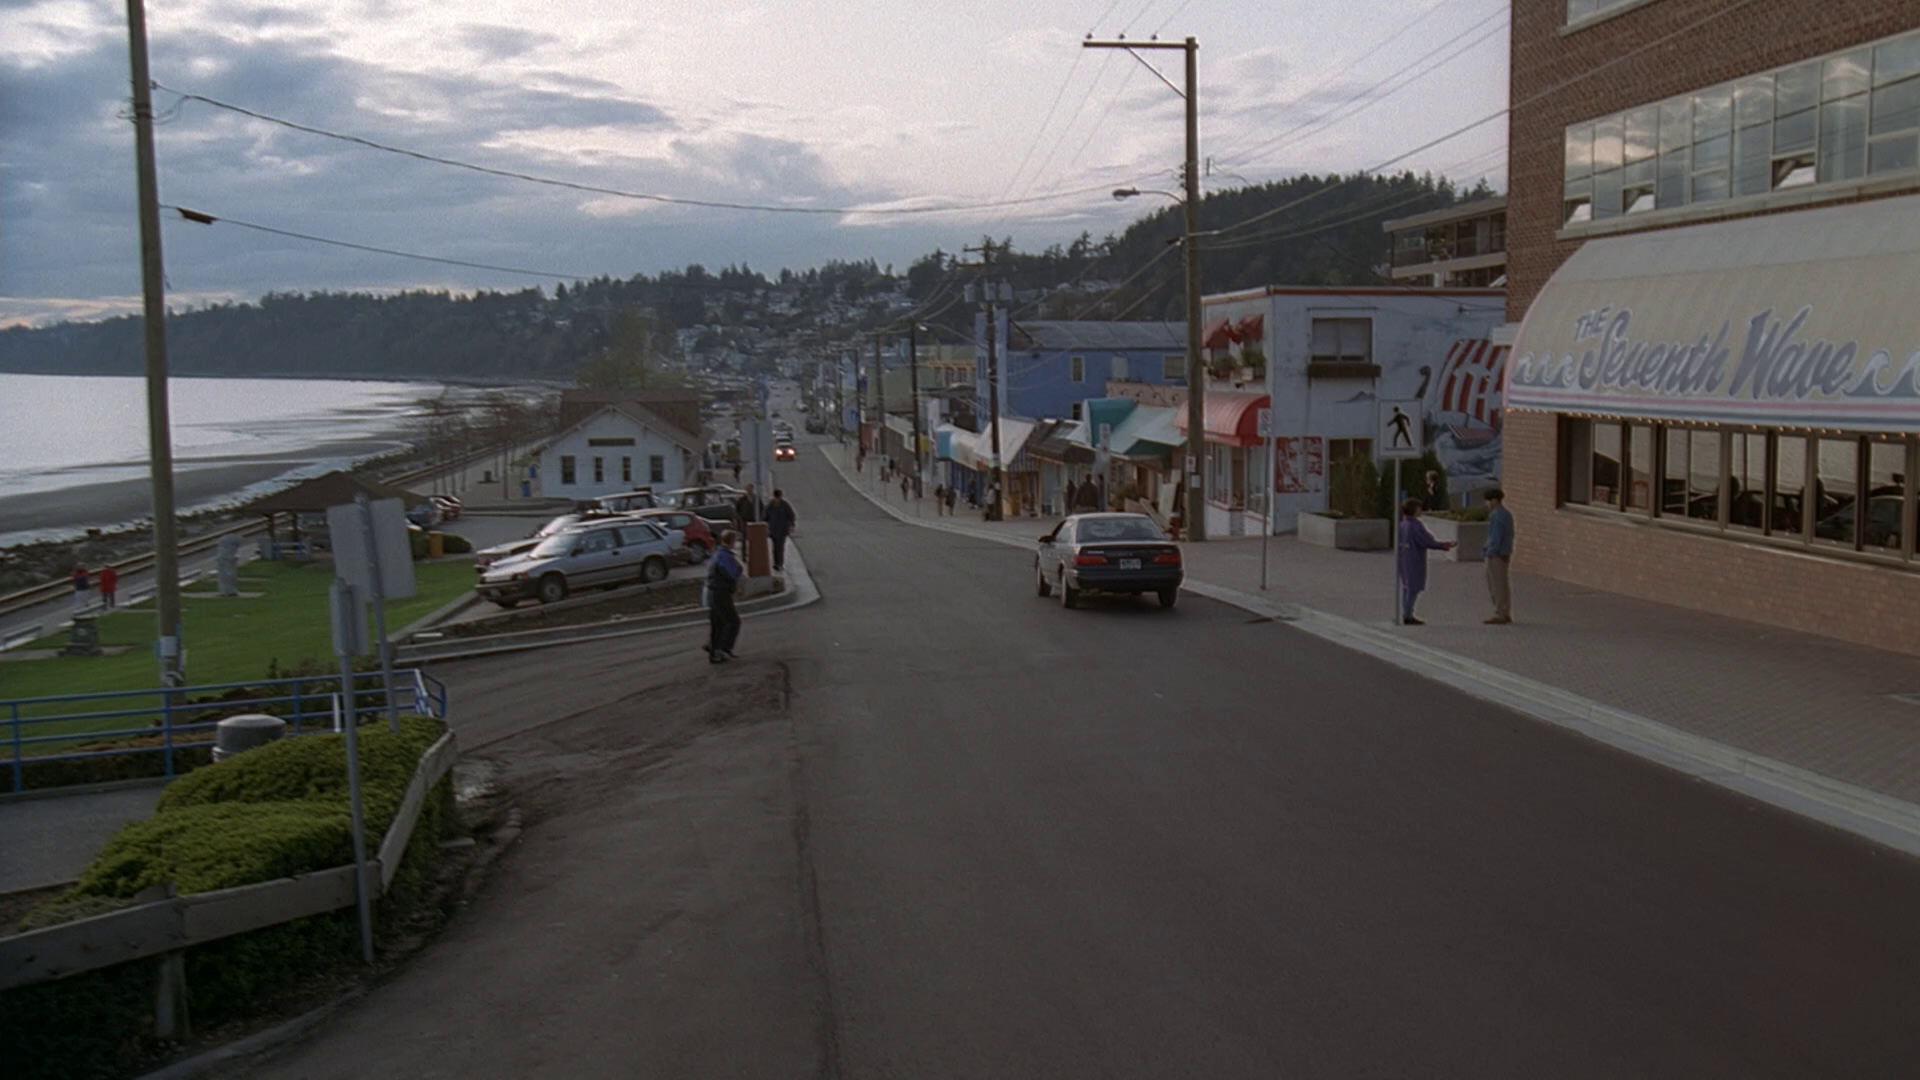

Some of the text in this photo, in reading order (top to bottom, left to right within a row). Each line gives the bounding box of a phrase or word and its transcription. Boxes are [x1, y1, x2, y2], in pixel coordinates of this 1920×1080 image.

[1575, 306, 1611, 342] THE
[1579, 305, 1858, 399] Seventh Wave
